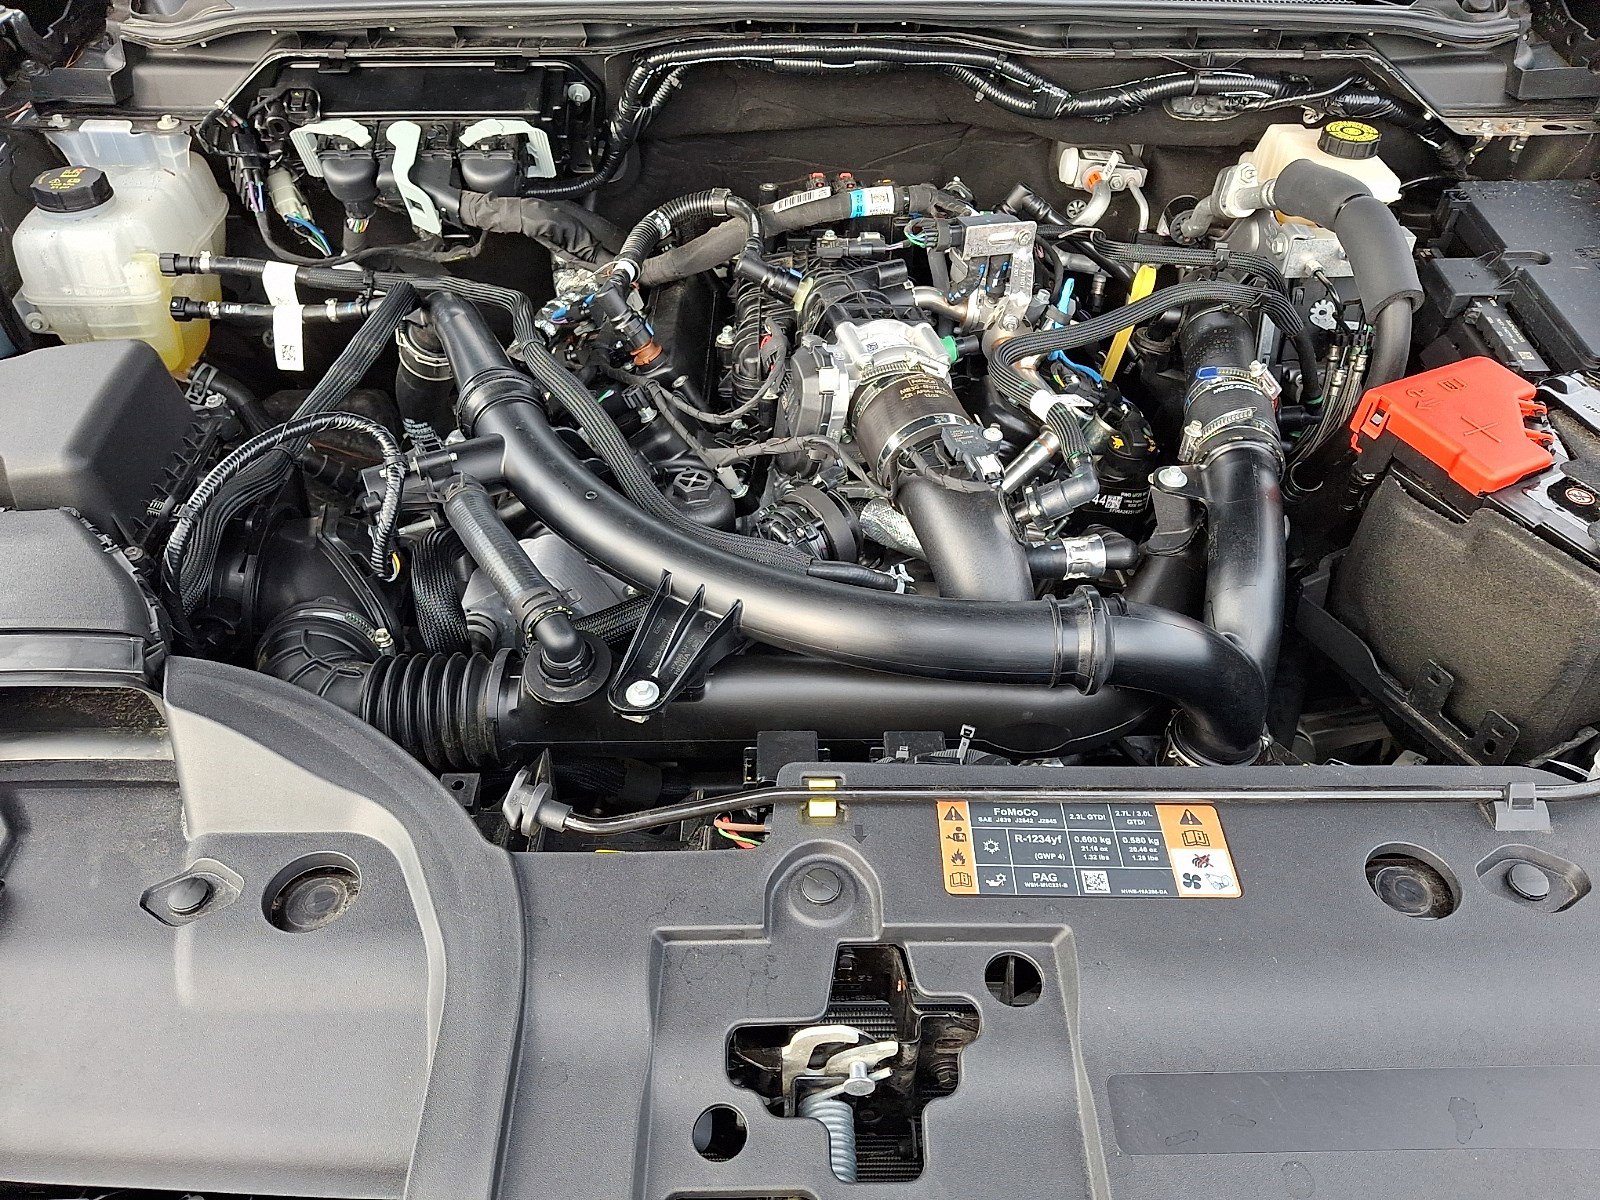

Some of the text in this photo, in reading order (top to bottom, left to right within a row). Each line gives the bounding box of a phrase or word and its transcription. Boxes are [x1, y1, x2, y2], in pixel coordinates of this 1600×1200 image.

[993, 807, 1039, 817] FoMoCo
[1069, 813, 1086, 821] 2.3L
[1014, 834, 1062, 846] R-1234yf
[1074, 835, 1112, 846] 0.600 kg
[1122, 836, 1160, 847] 0.580 kg
[1034, 852, 1066, 862] (GWP 4)
[1098, 854, 1110, 862] lbs
[1147, 855, 1160, 863] lbs
[1032, 872, 1058, 883] PAG
